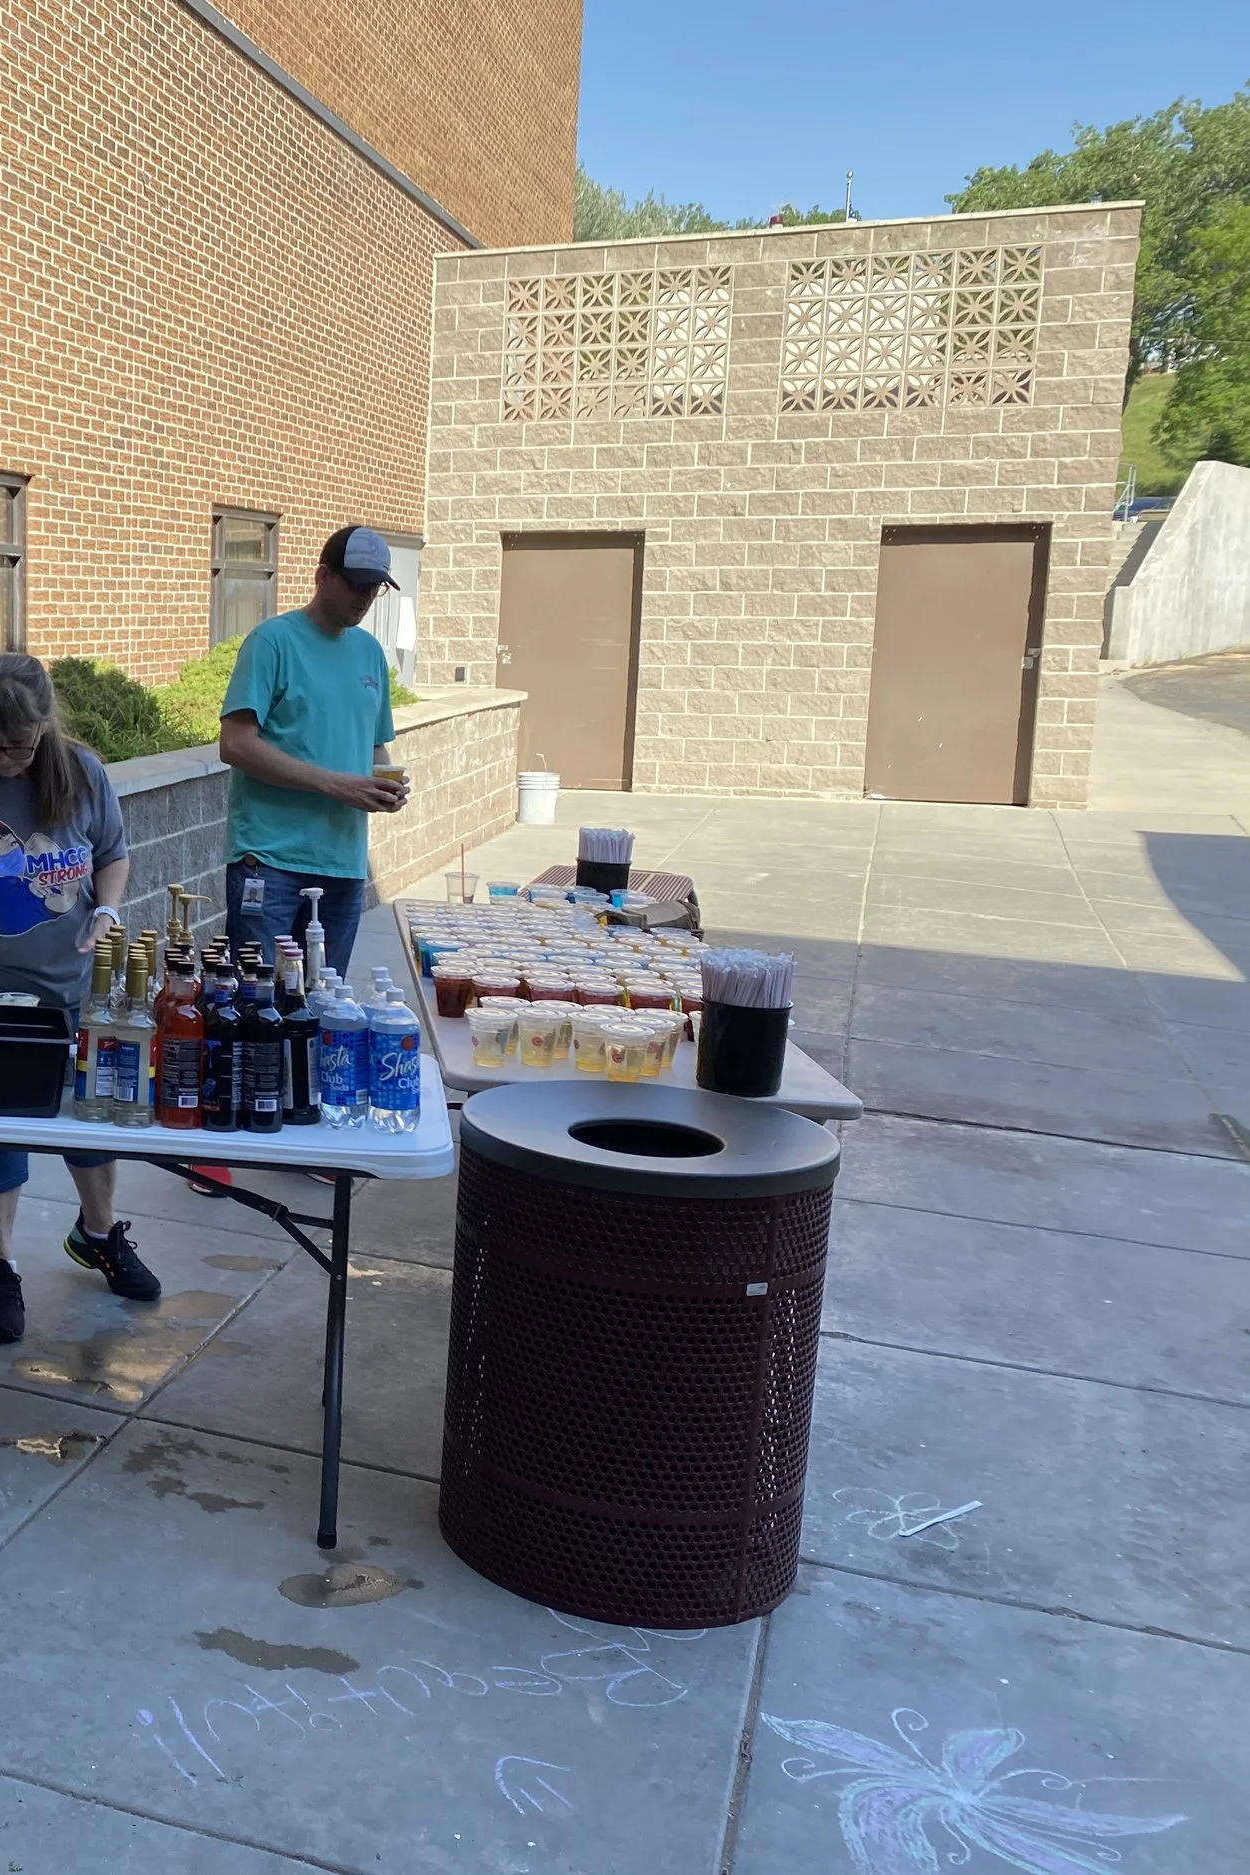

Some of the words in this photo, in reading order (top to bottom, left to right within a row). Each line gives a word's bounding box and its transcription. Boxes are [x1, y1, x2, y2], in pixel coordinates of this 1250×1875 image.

[25, 846, 87, 874] MHCC
[321, 1071, 343, 1085] Club
[379, 1052, 418, 1081] Shas
[135, 1610, 688, 1788] Beautiful!
